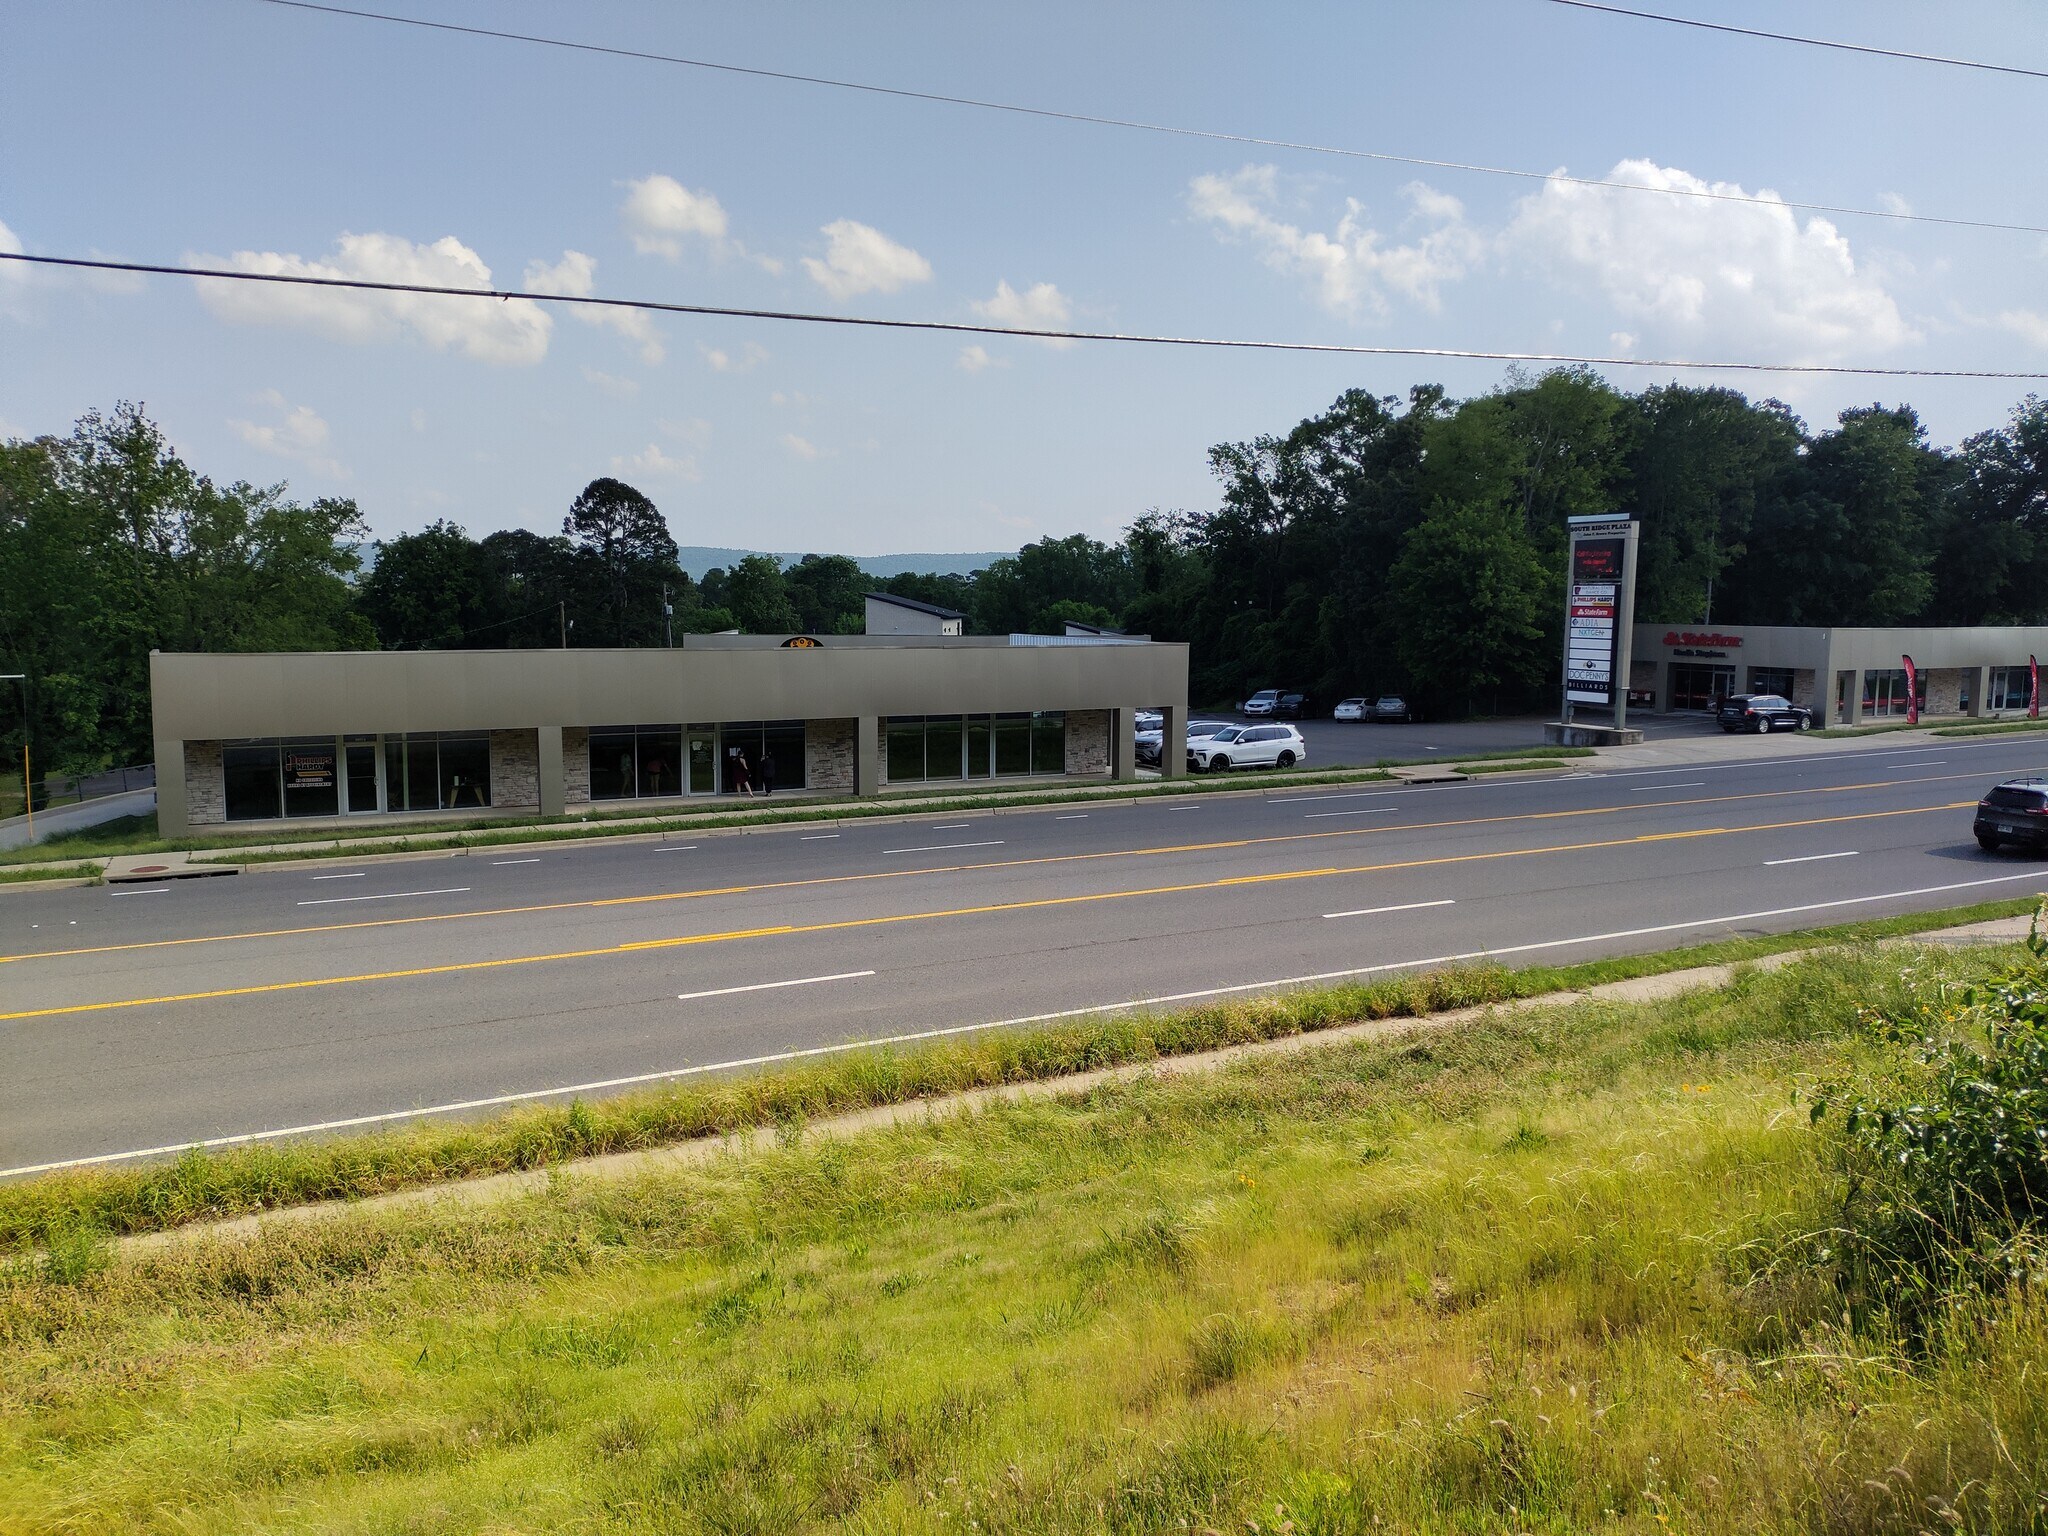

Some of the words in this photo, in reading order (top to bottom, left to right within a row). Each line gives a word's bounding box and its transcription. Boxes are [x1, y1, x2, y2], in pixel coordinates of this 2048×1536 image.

[1580, 619, 1599, 627] ADIA
[1568, 682, 1608, 690] BILLIARDS
[296, 756, 332, 764] PHILLIPS
